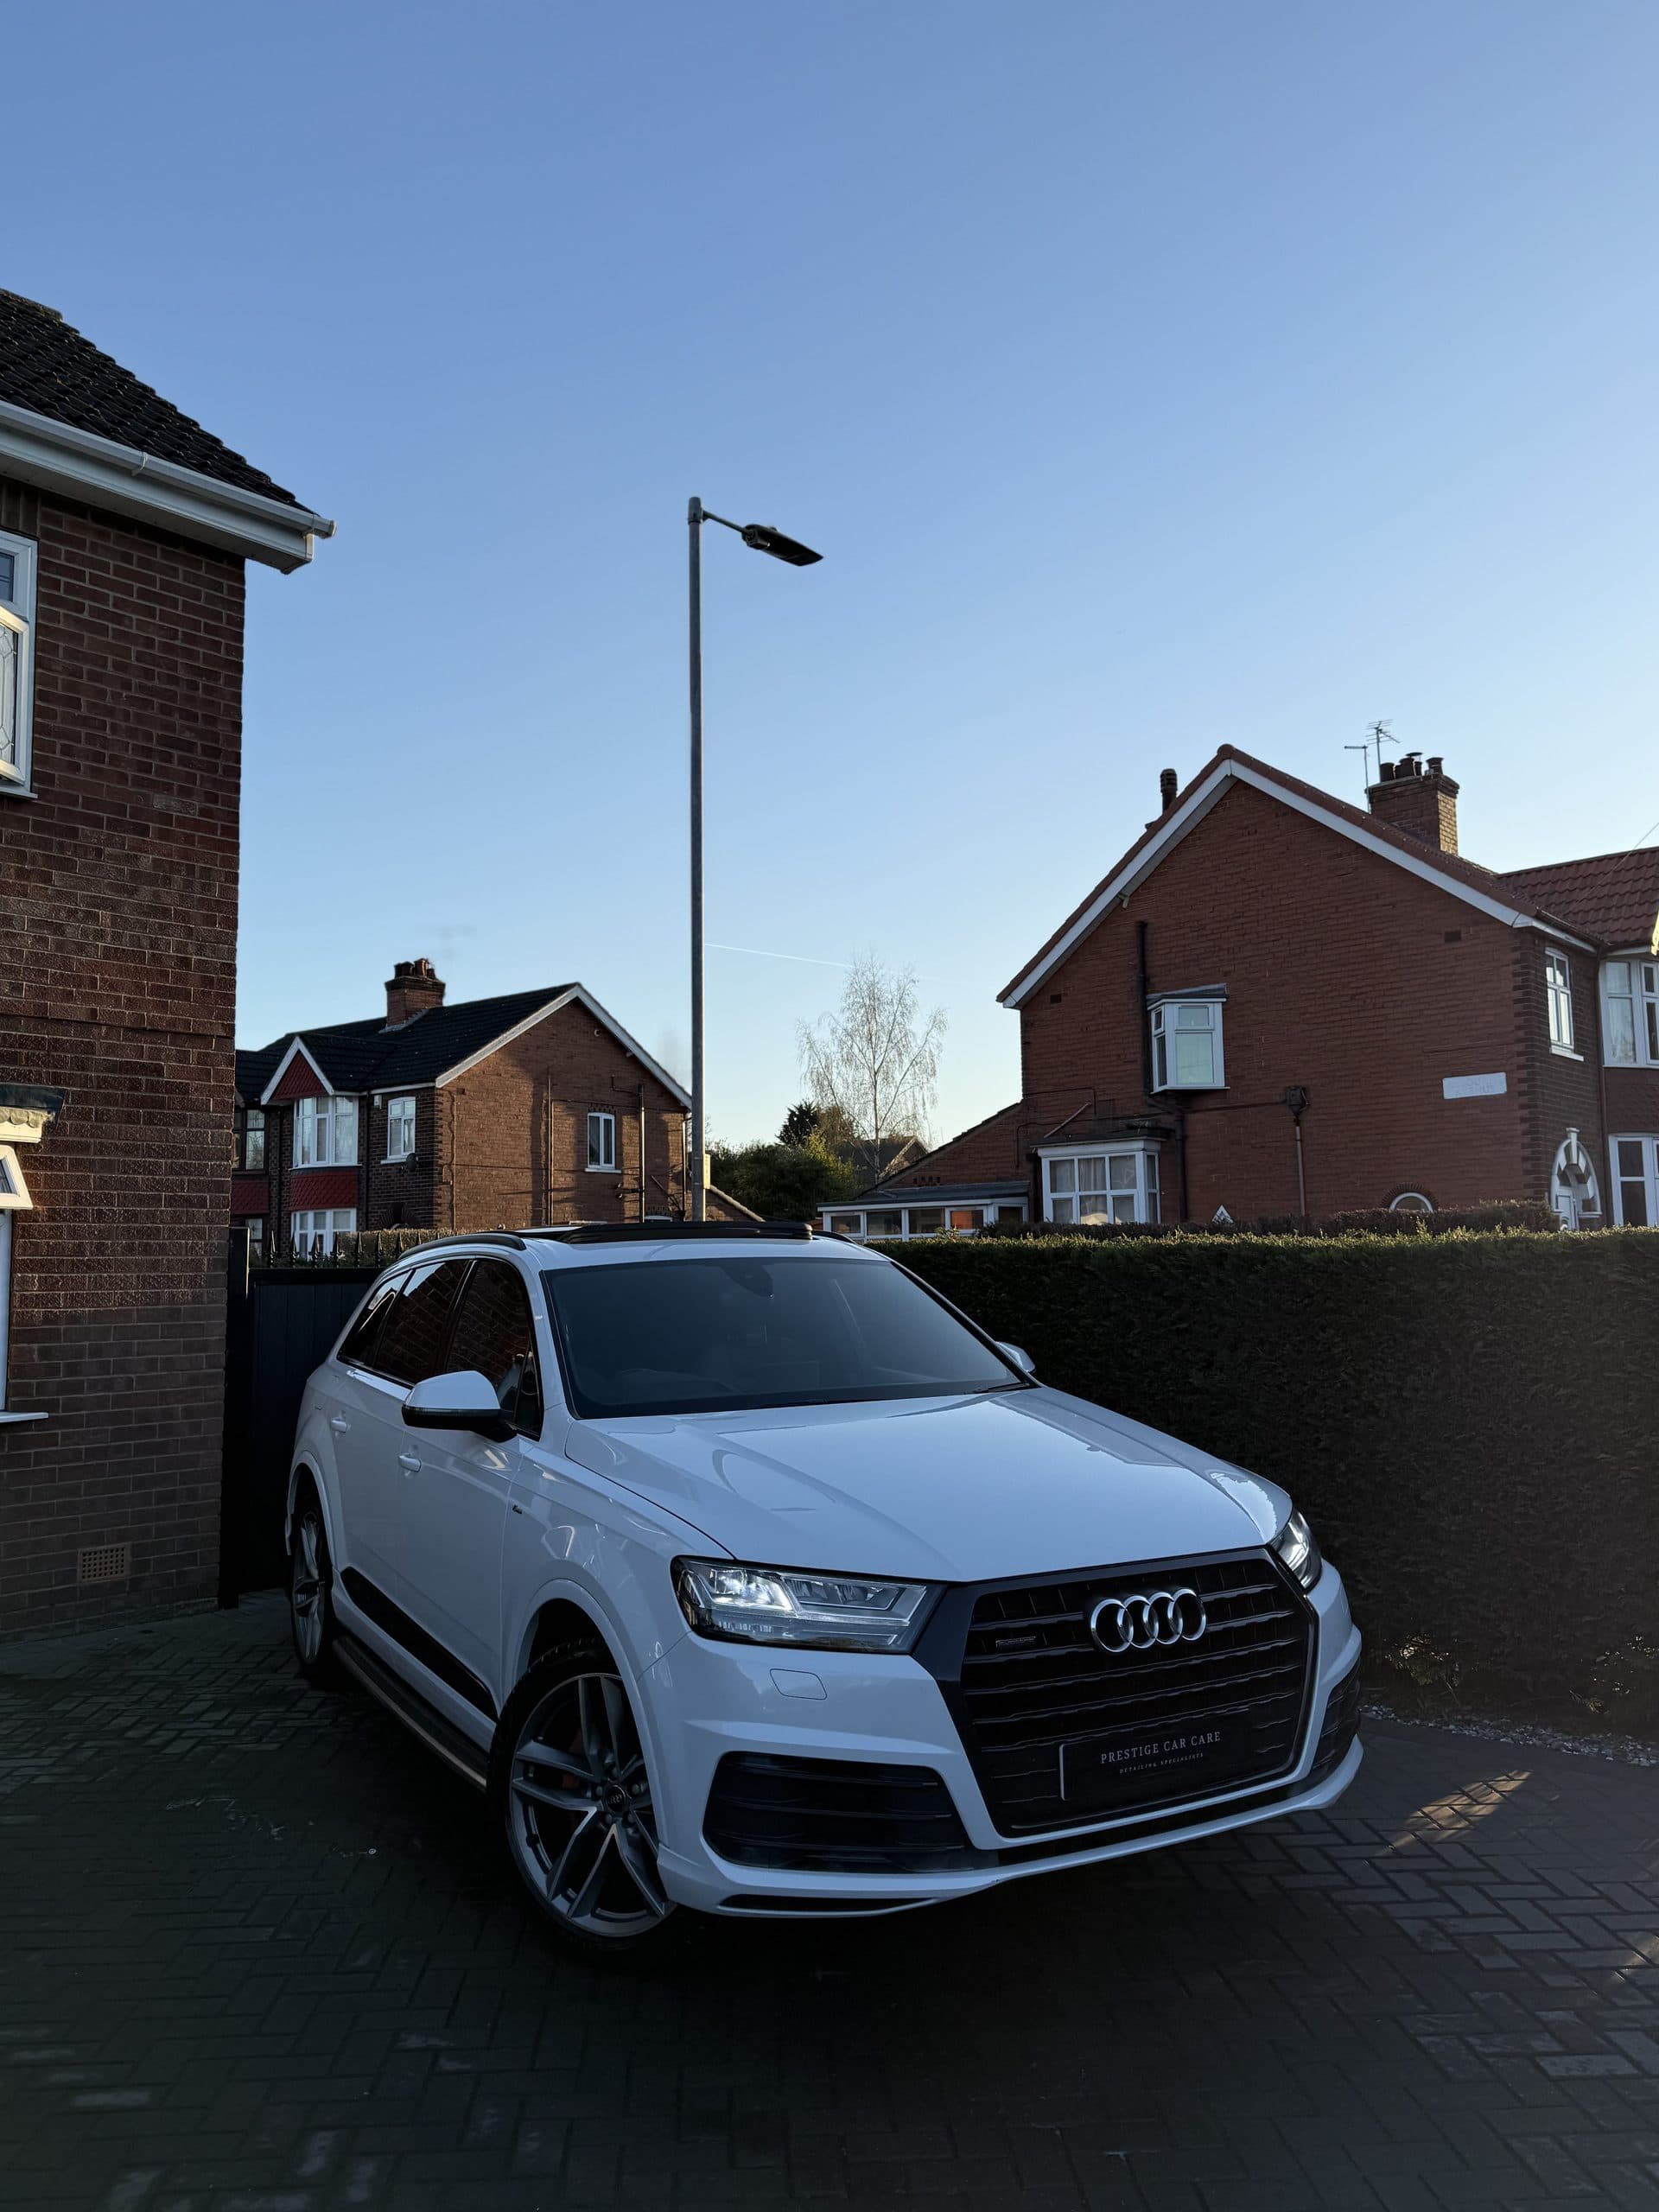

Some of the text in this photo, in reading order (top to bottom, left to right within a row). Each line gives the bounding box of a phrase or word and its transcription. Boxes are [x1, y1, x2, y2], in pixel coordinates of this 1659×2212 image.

[1101, 1731, 1221, 1764] PRESTIGE CAR CARE
[1119, 1762, 1158, 1774] DETAILING
